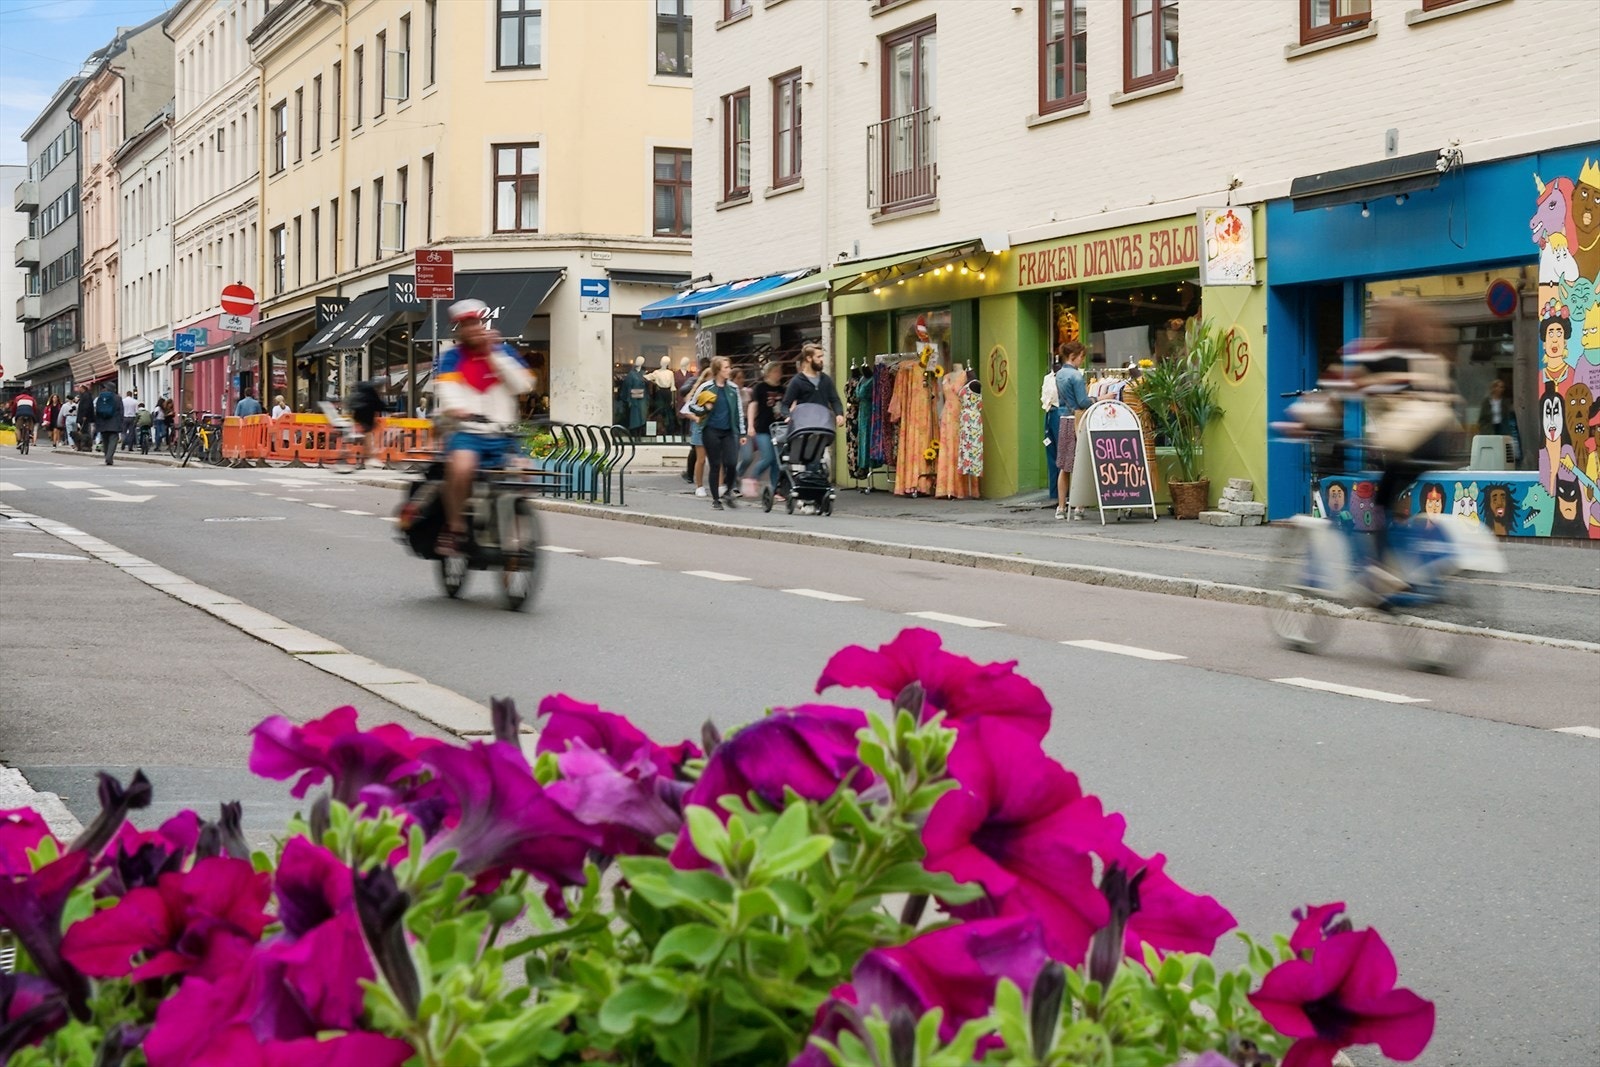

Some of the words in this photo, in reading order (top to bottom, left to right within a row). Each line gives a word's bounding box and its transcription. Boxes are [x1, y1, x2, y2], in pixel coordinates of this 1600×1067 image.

[1018, 245, 1078, 286] FRØKEN
[1083, 234, 1143, 277] DIANAS
[1099, 462, 1146, 488] 50-70%
